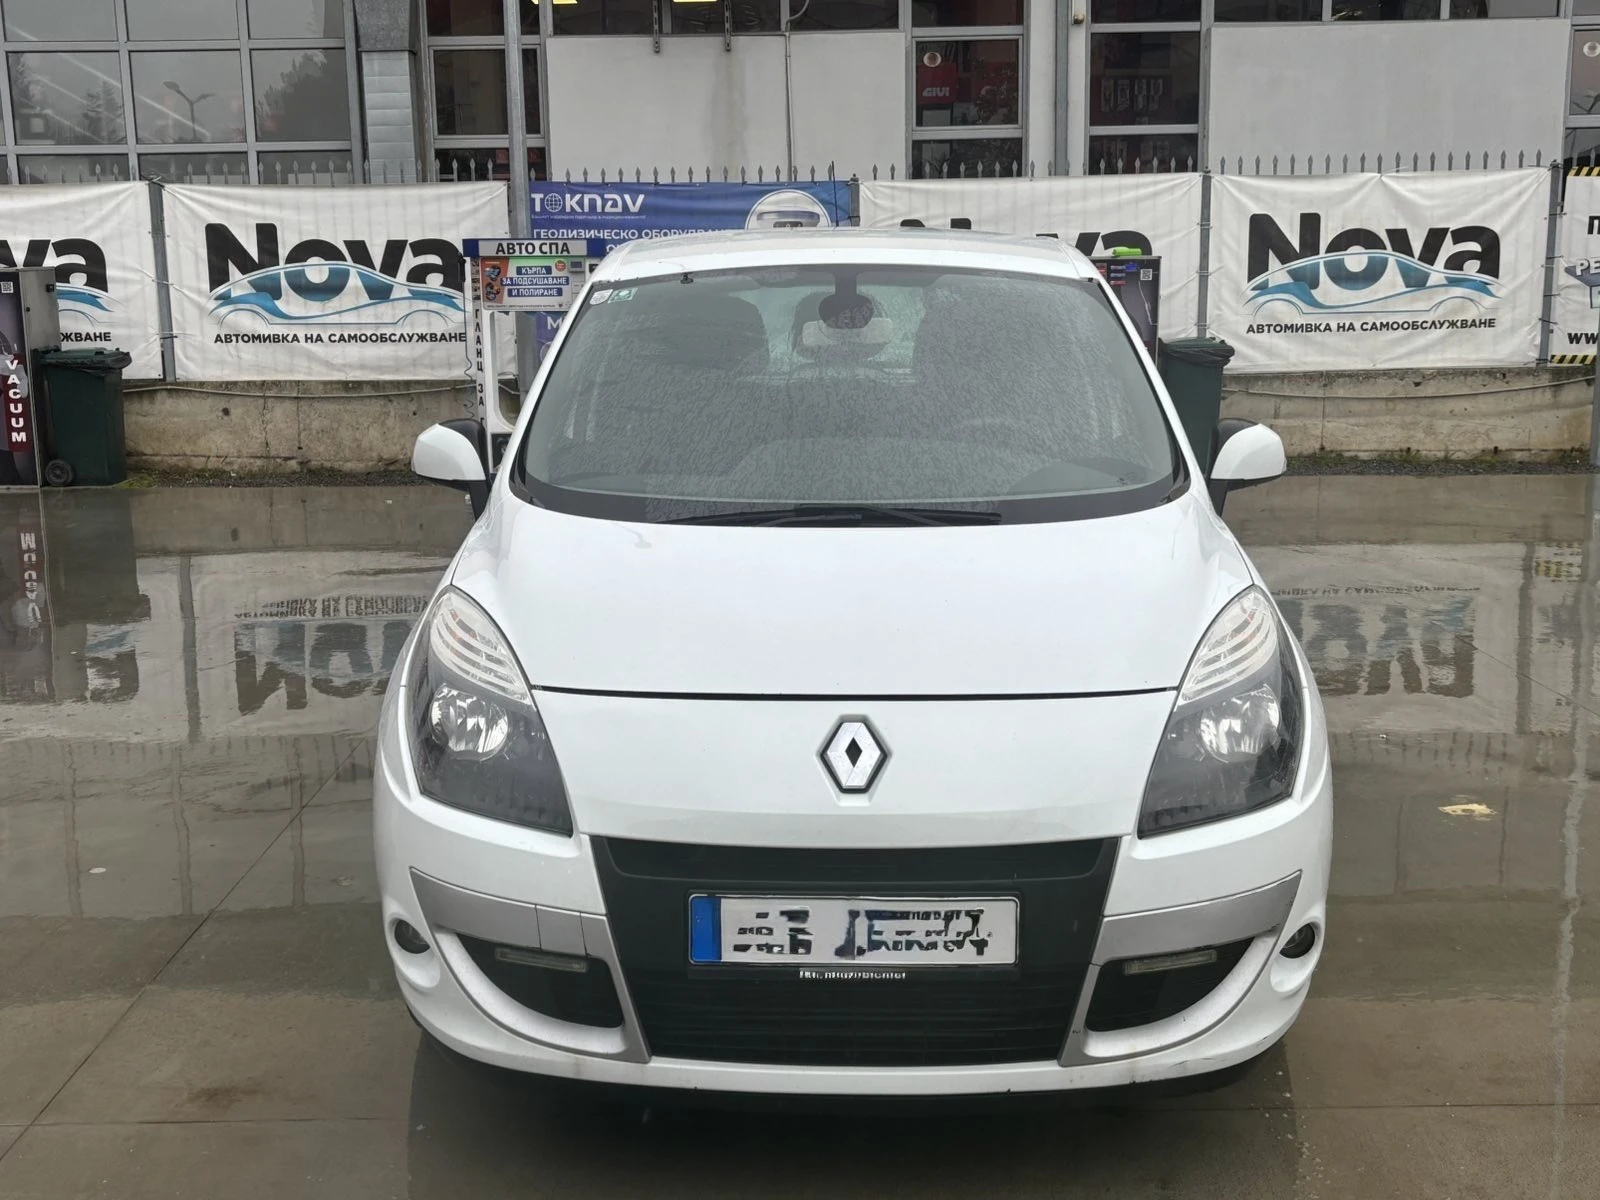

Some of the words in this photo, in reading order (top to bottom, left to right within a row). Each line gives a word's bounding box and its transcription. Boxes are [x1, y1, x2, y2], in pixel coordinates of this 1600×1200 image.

[533, 229, 638, 240] ГЕОДИЗИЧЕСКО
[495, 242, 535, 255] АВТО
[538, 242, 571, 255] СПА
[1247, 212, 1501, 290] Nova
[204, 222, 464, 301] Nova
[521, 267, 547, 275] КЪРПА
[502, 277, 512, 285] ЗА
[513, 277, 568, 285] ПОДСУШАВАНЕ
[511, 288, 519, 296] И
[519, 288, 559, 296] ПОЛИРАНЕ
[1246, 322, 1332, 335] АВТОМИВКА
[1336, 321, 1356, 333] НА
[1360, 318, 1497, 333] САМООБСЛУЖВАНЕ
[214, 333, 301, 344] АВТОМИВКА
[304, 333, 323, 344] НА
[327, 332, 467, 344] САМООБСЛУЖВАНЕ
[5, 359, 27, 443] VACUUM
